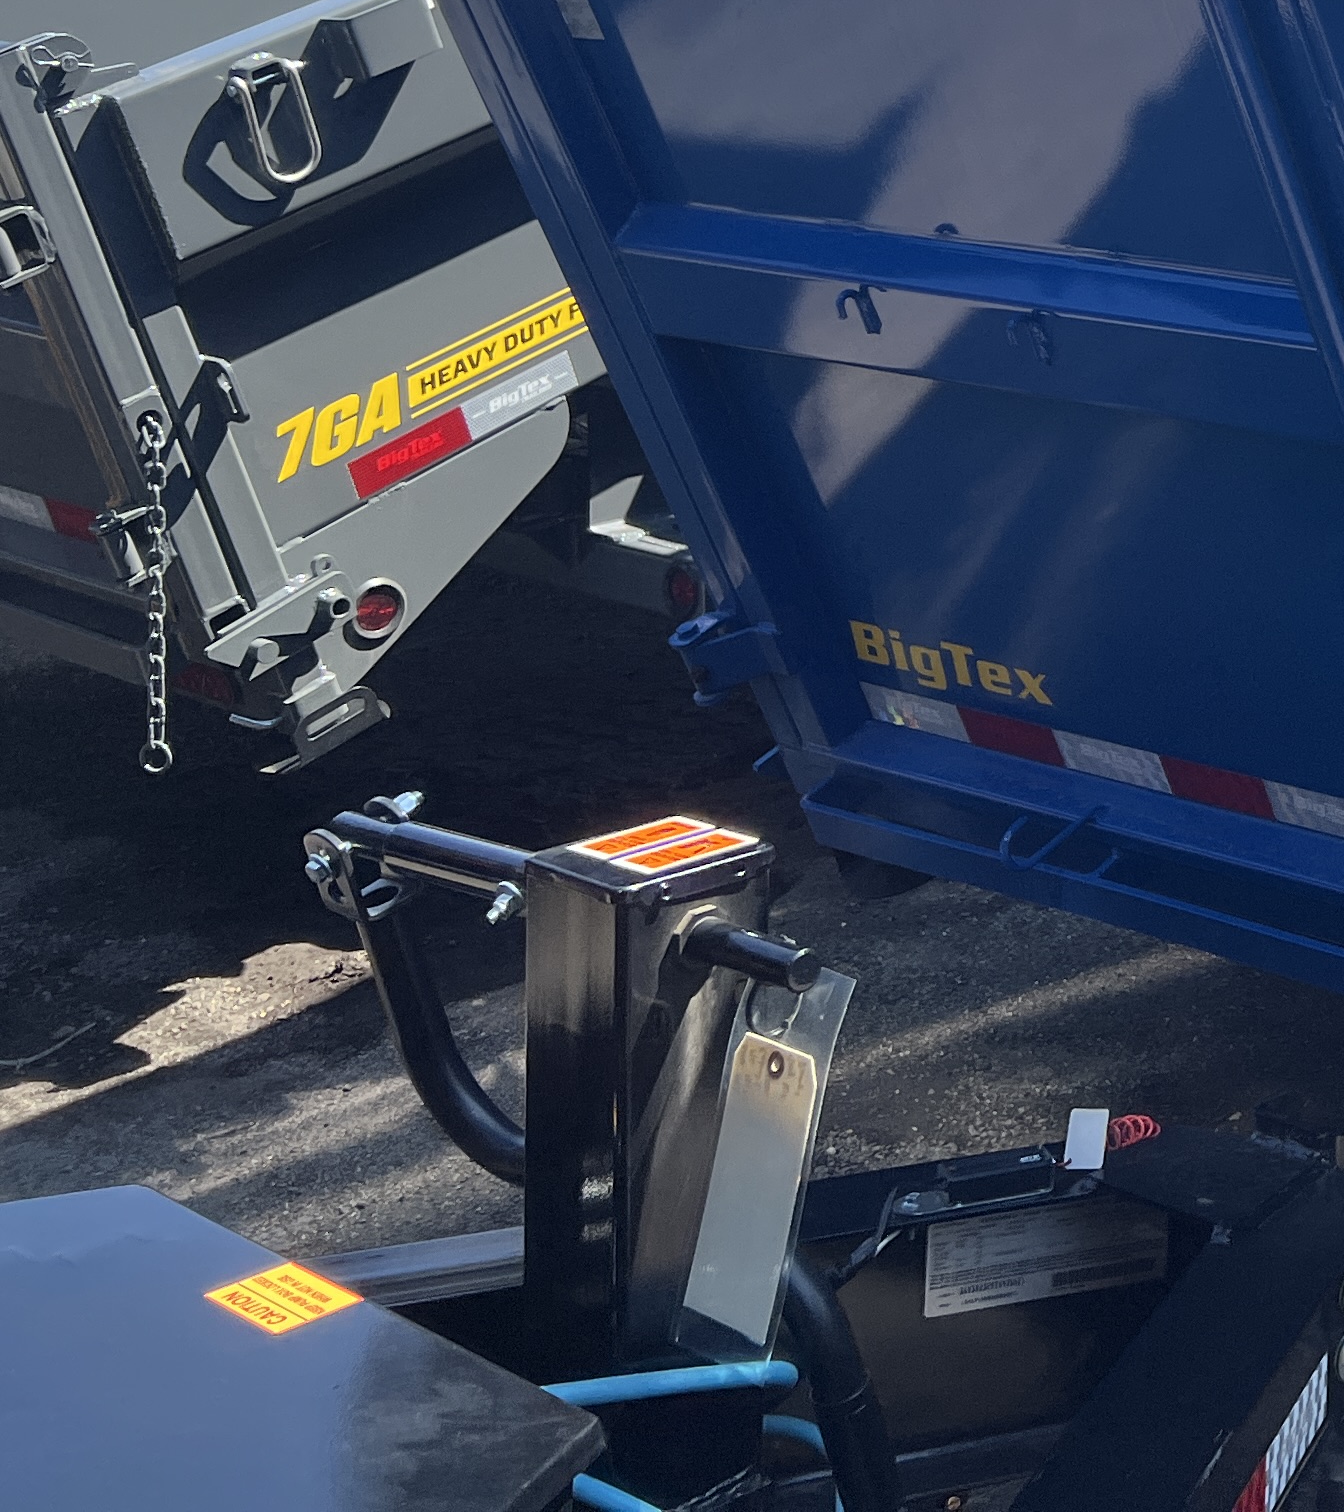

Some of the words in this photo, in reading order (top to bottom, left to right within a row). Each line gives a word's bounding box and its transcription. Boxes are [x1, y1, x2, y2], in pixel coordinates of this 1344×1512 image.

[419, 340, 497, 396] HEAVY
[503, 310, 561, 354] DUTY
[488, 373, 551, 414] BigTex
[276, 371, 401, 484] 7GA
[376, 430, 442, 472] BigTex
[849, 619, 1053, 706] BigTex
[221, 1291, 288, 1325] CAUTION
